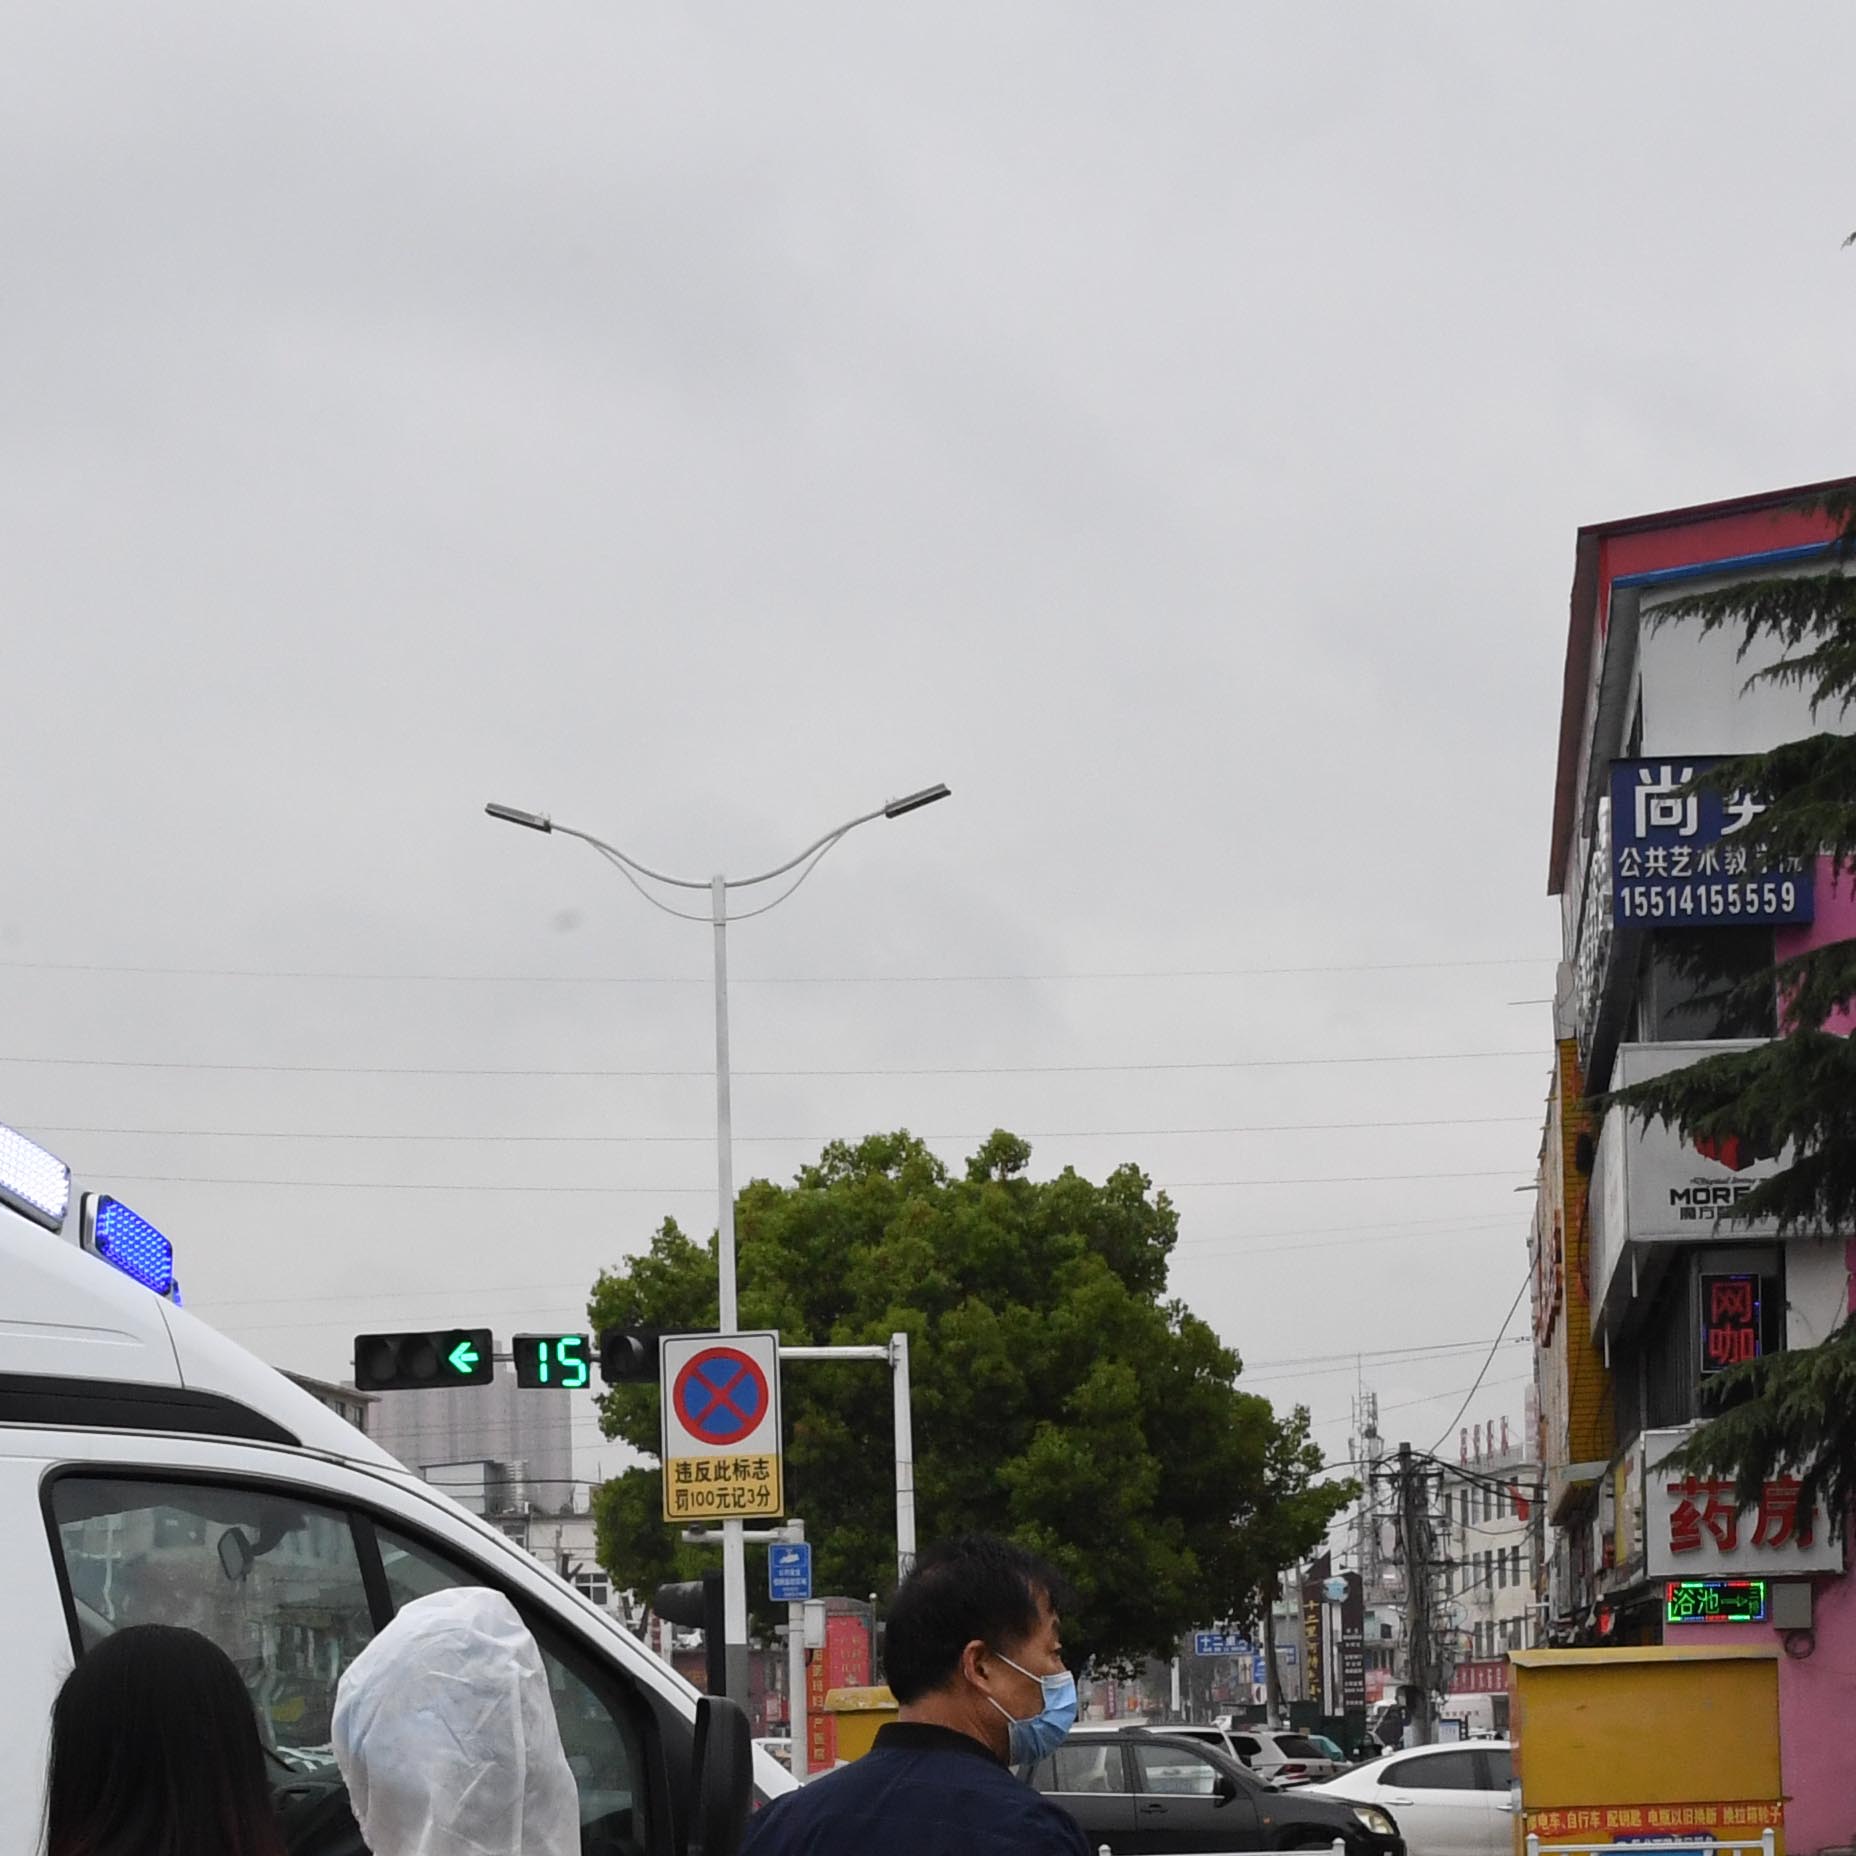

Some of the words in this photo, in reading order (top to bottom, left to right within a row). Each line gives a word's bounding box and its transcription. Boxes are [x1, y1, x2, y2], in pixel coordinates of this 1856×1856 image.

[1620, 881, 1795, 917] 15514155559
[1709, 1281, 1755, 1364] 网咖
[538, 1337, 588, 1388] 15
[675, 1458, 770, 1484] 违反此标志
[675, 1485, 771, 1511] 罚100元记3分
[1667, 1473, 1819, 1552] 药房
[1672, 1587, 1720, 1616] 浴池
